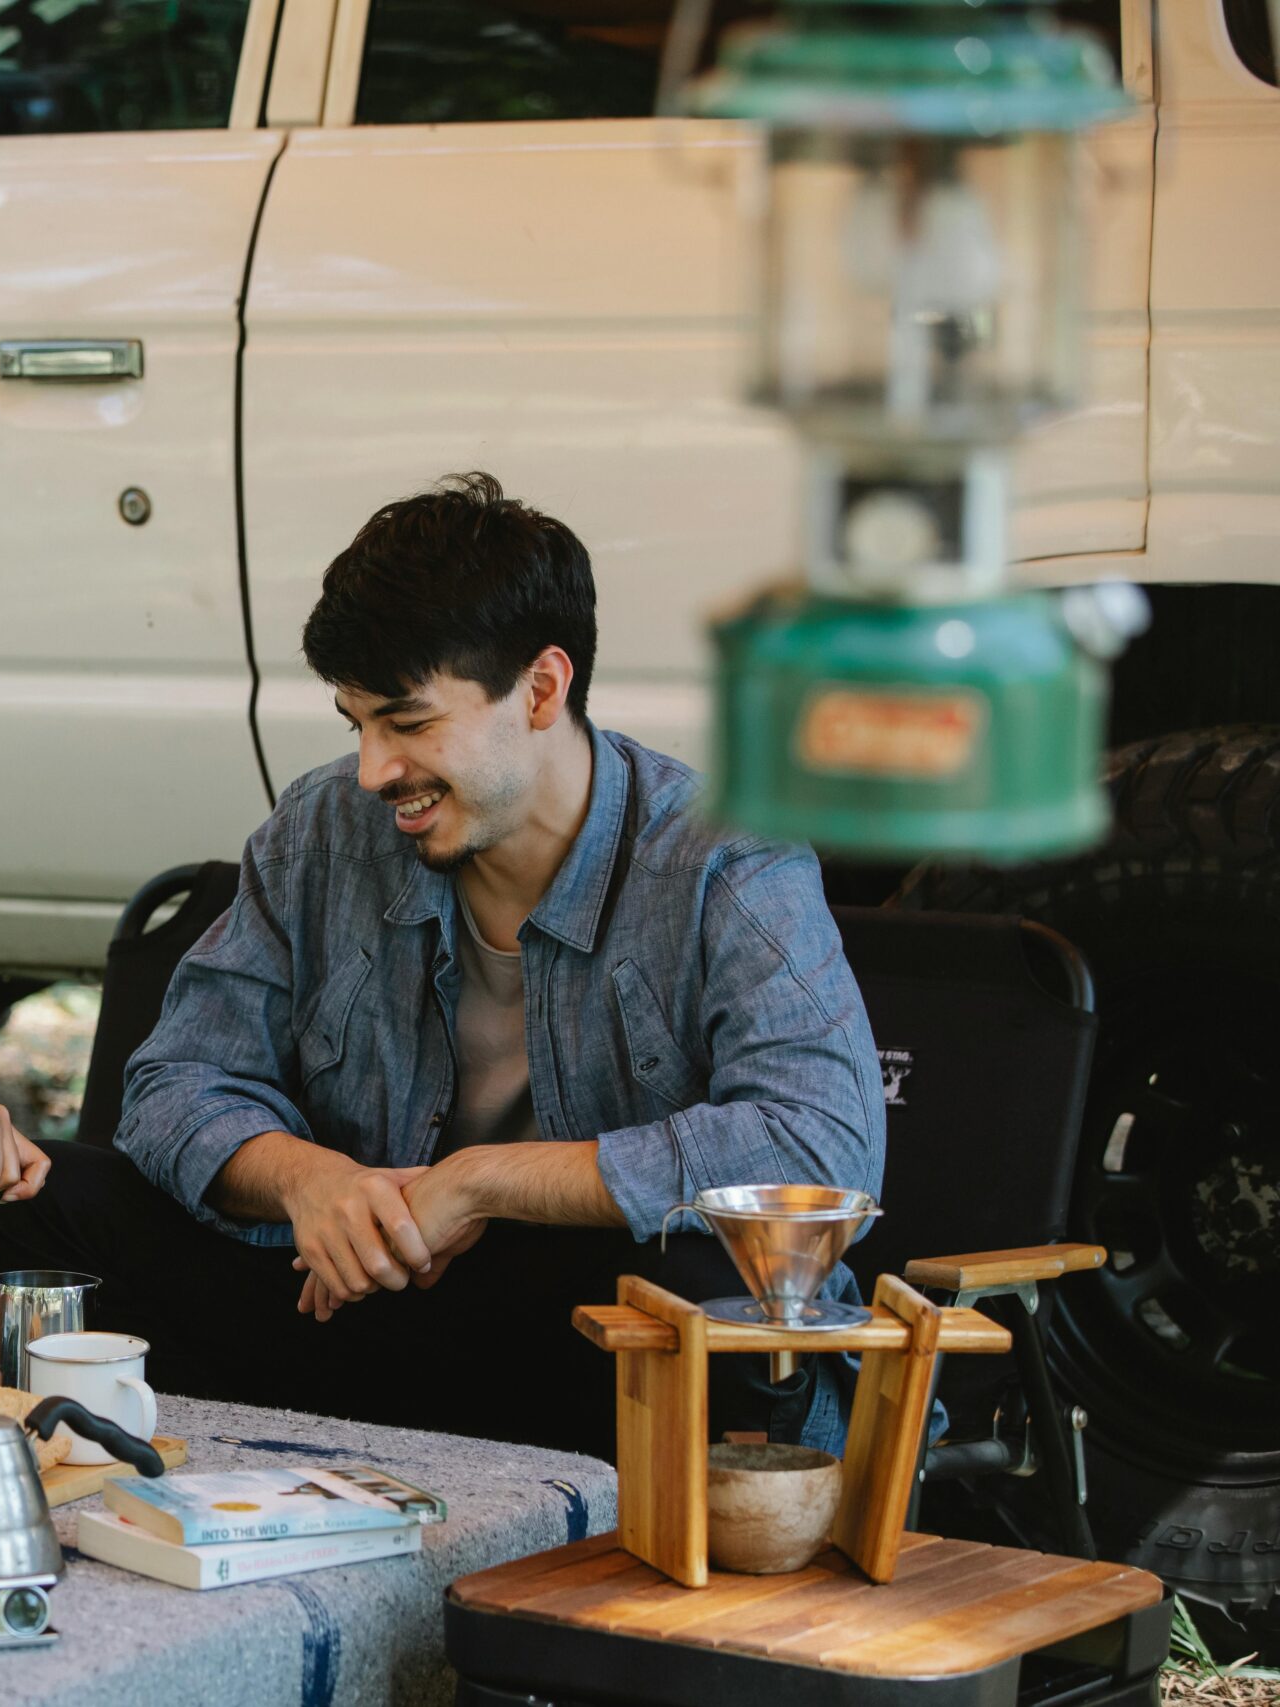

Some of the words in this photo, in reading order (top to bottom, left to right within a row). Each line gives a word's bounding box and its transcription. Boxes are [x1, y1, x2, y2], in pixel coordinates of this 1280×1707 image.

[202, 1529, 229, 1541] INTO
[232, 1526, 255, 1538] THE
[258, 1523, 288, 1537] WILD
[303, 1520, 323, 1531] Jon
